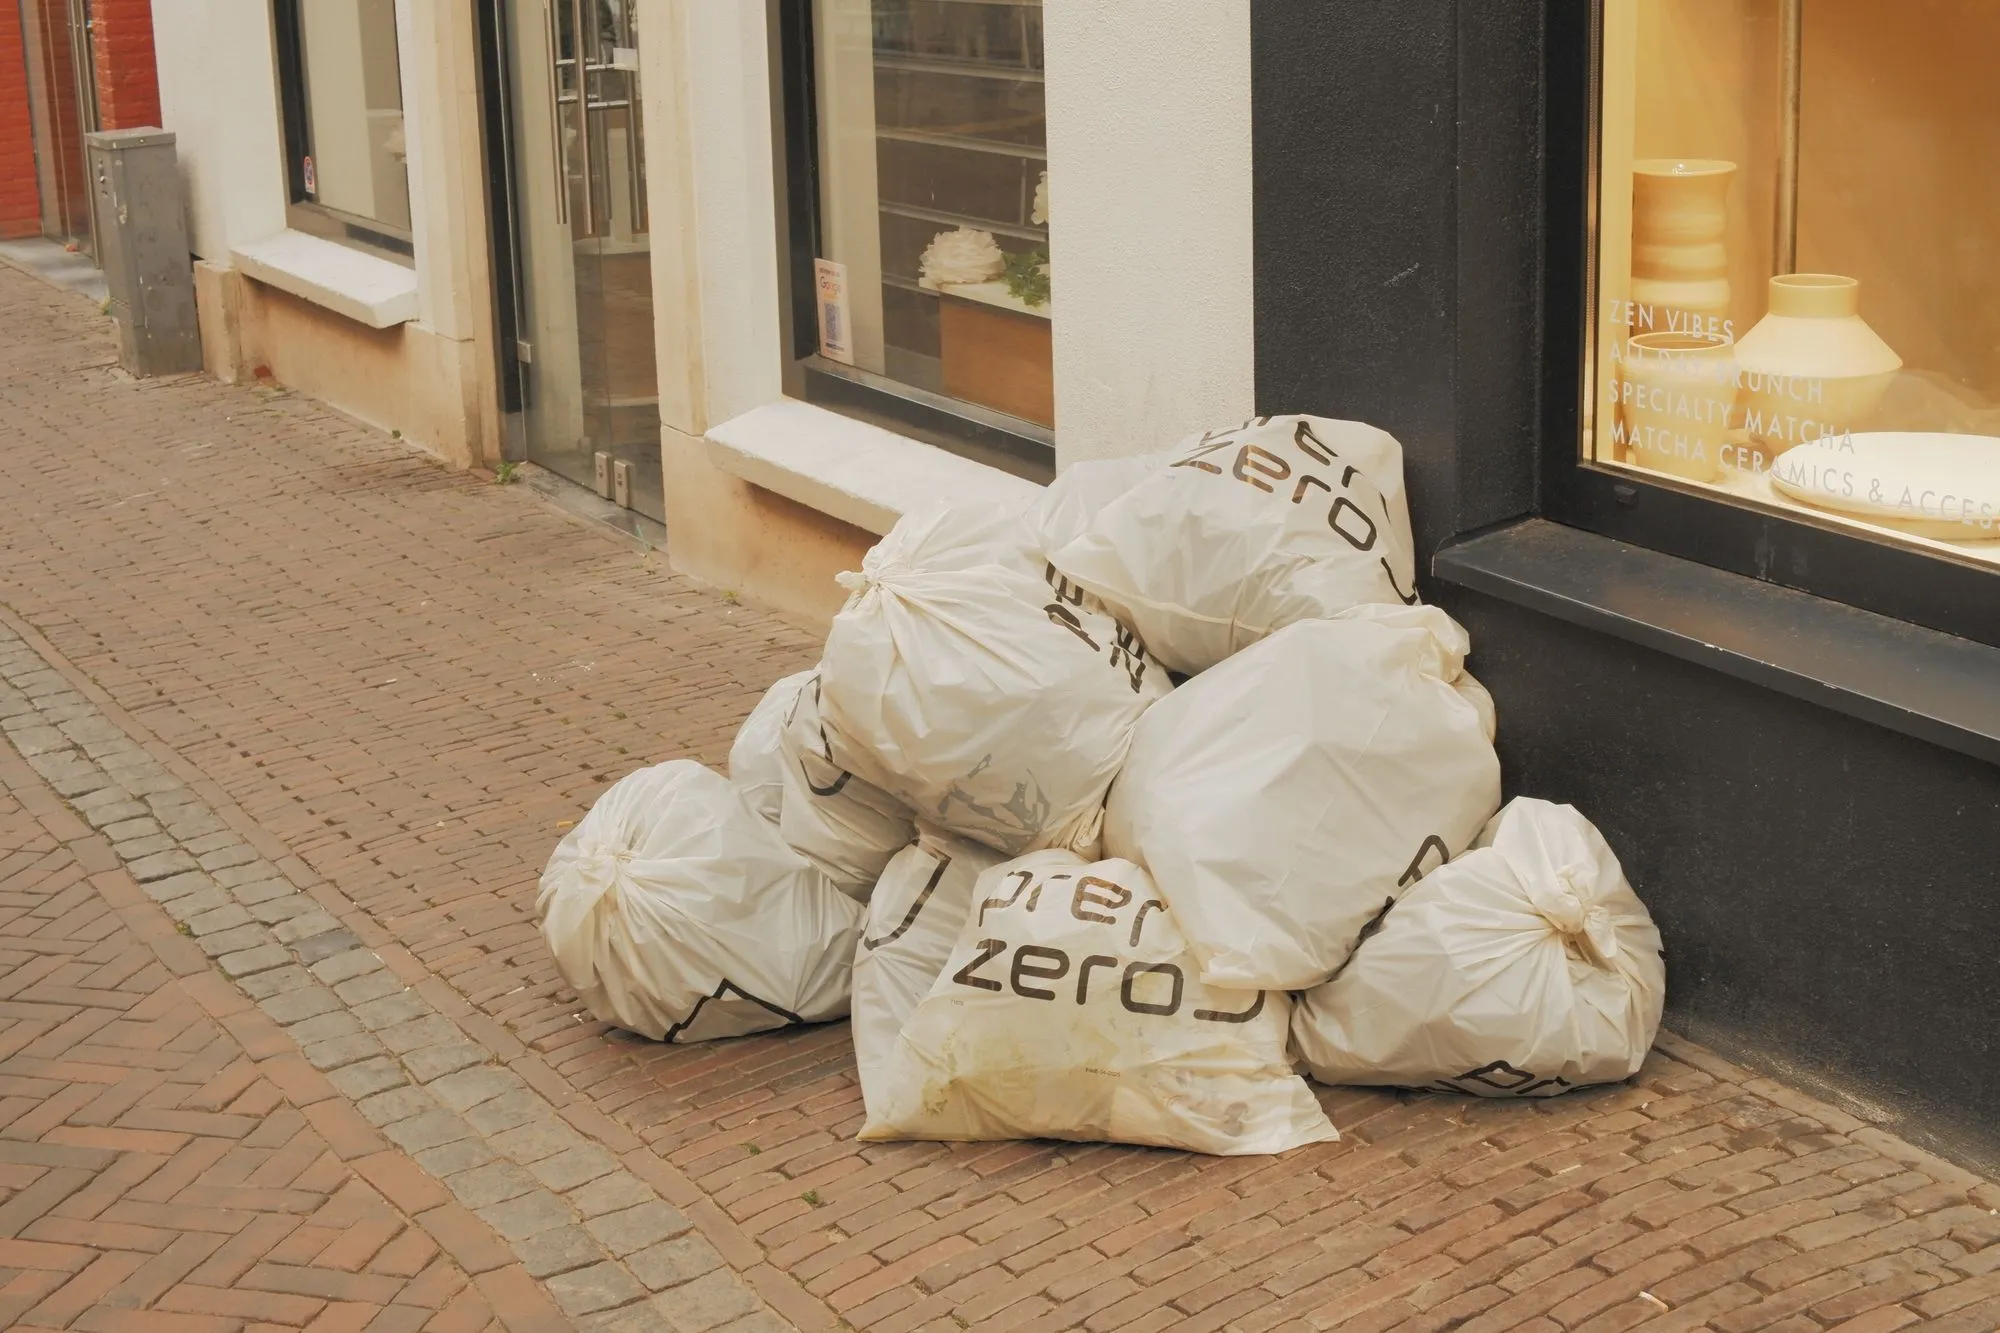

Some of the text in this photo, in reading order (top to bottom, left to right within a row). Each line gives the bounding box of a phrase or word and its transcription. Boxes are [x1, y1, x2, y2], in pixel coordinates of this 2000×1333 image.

[1609, 299, 1734, 345] ZEN VIBES
[1608, 379, 1855, 454] SPECIALTY MATCHA
[1716, 360, 1822, 404] BRUNCH
[1608, 419, 2000, 534] MATCHA CERAMICS & ACCES
[952, 937, 1184, 1017] zero
